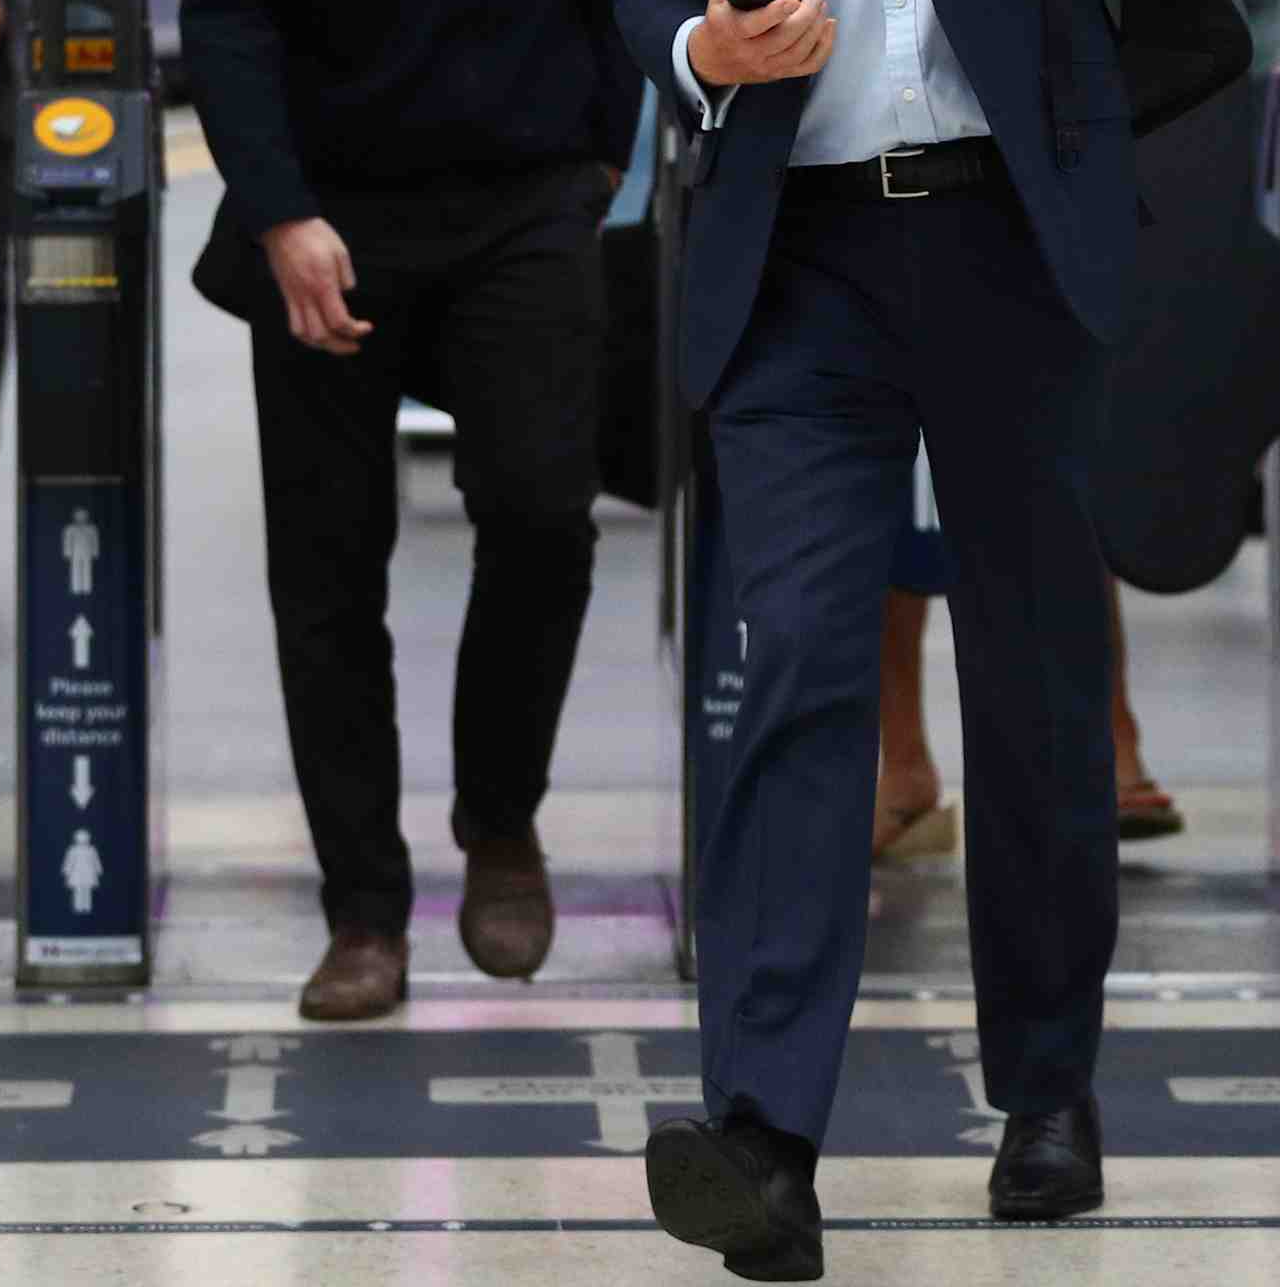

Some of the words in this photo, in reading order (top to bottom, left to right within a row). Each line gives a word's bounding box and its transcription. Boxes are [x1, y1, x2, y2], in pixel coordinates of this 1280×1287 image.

[51, 677, 112, 695] Please
[35, 702, 81, 725] keep
[86, 706, 127, 726] your
[41, 727, 122, 746] distance
